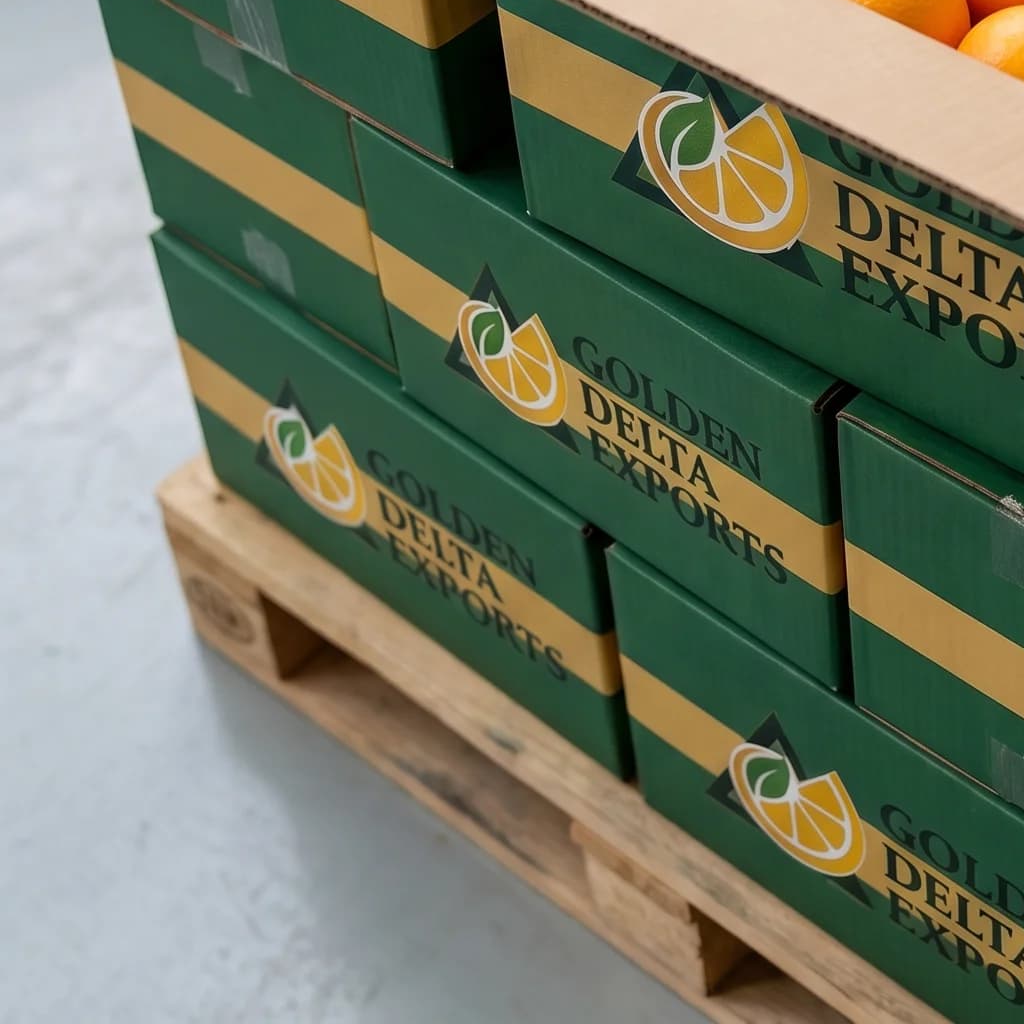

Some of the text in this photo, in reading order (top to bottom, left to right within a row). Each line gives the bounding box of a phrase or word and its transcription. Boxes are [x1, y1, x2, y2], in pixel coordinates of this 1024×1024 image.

[572, 336, 763, 481] GOLDEN
[579, 378, 721, 503] DELTA
[367, 449, 537, 587] GOLDEN
[377, 490, 505, 604] DELTA
[587, 425, 788, 585] EXPORTS
[386, 531, 568, 682] EXPORTS
